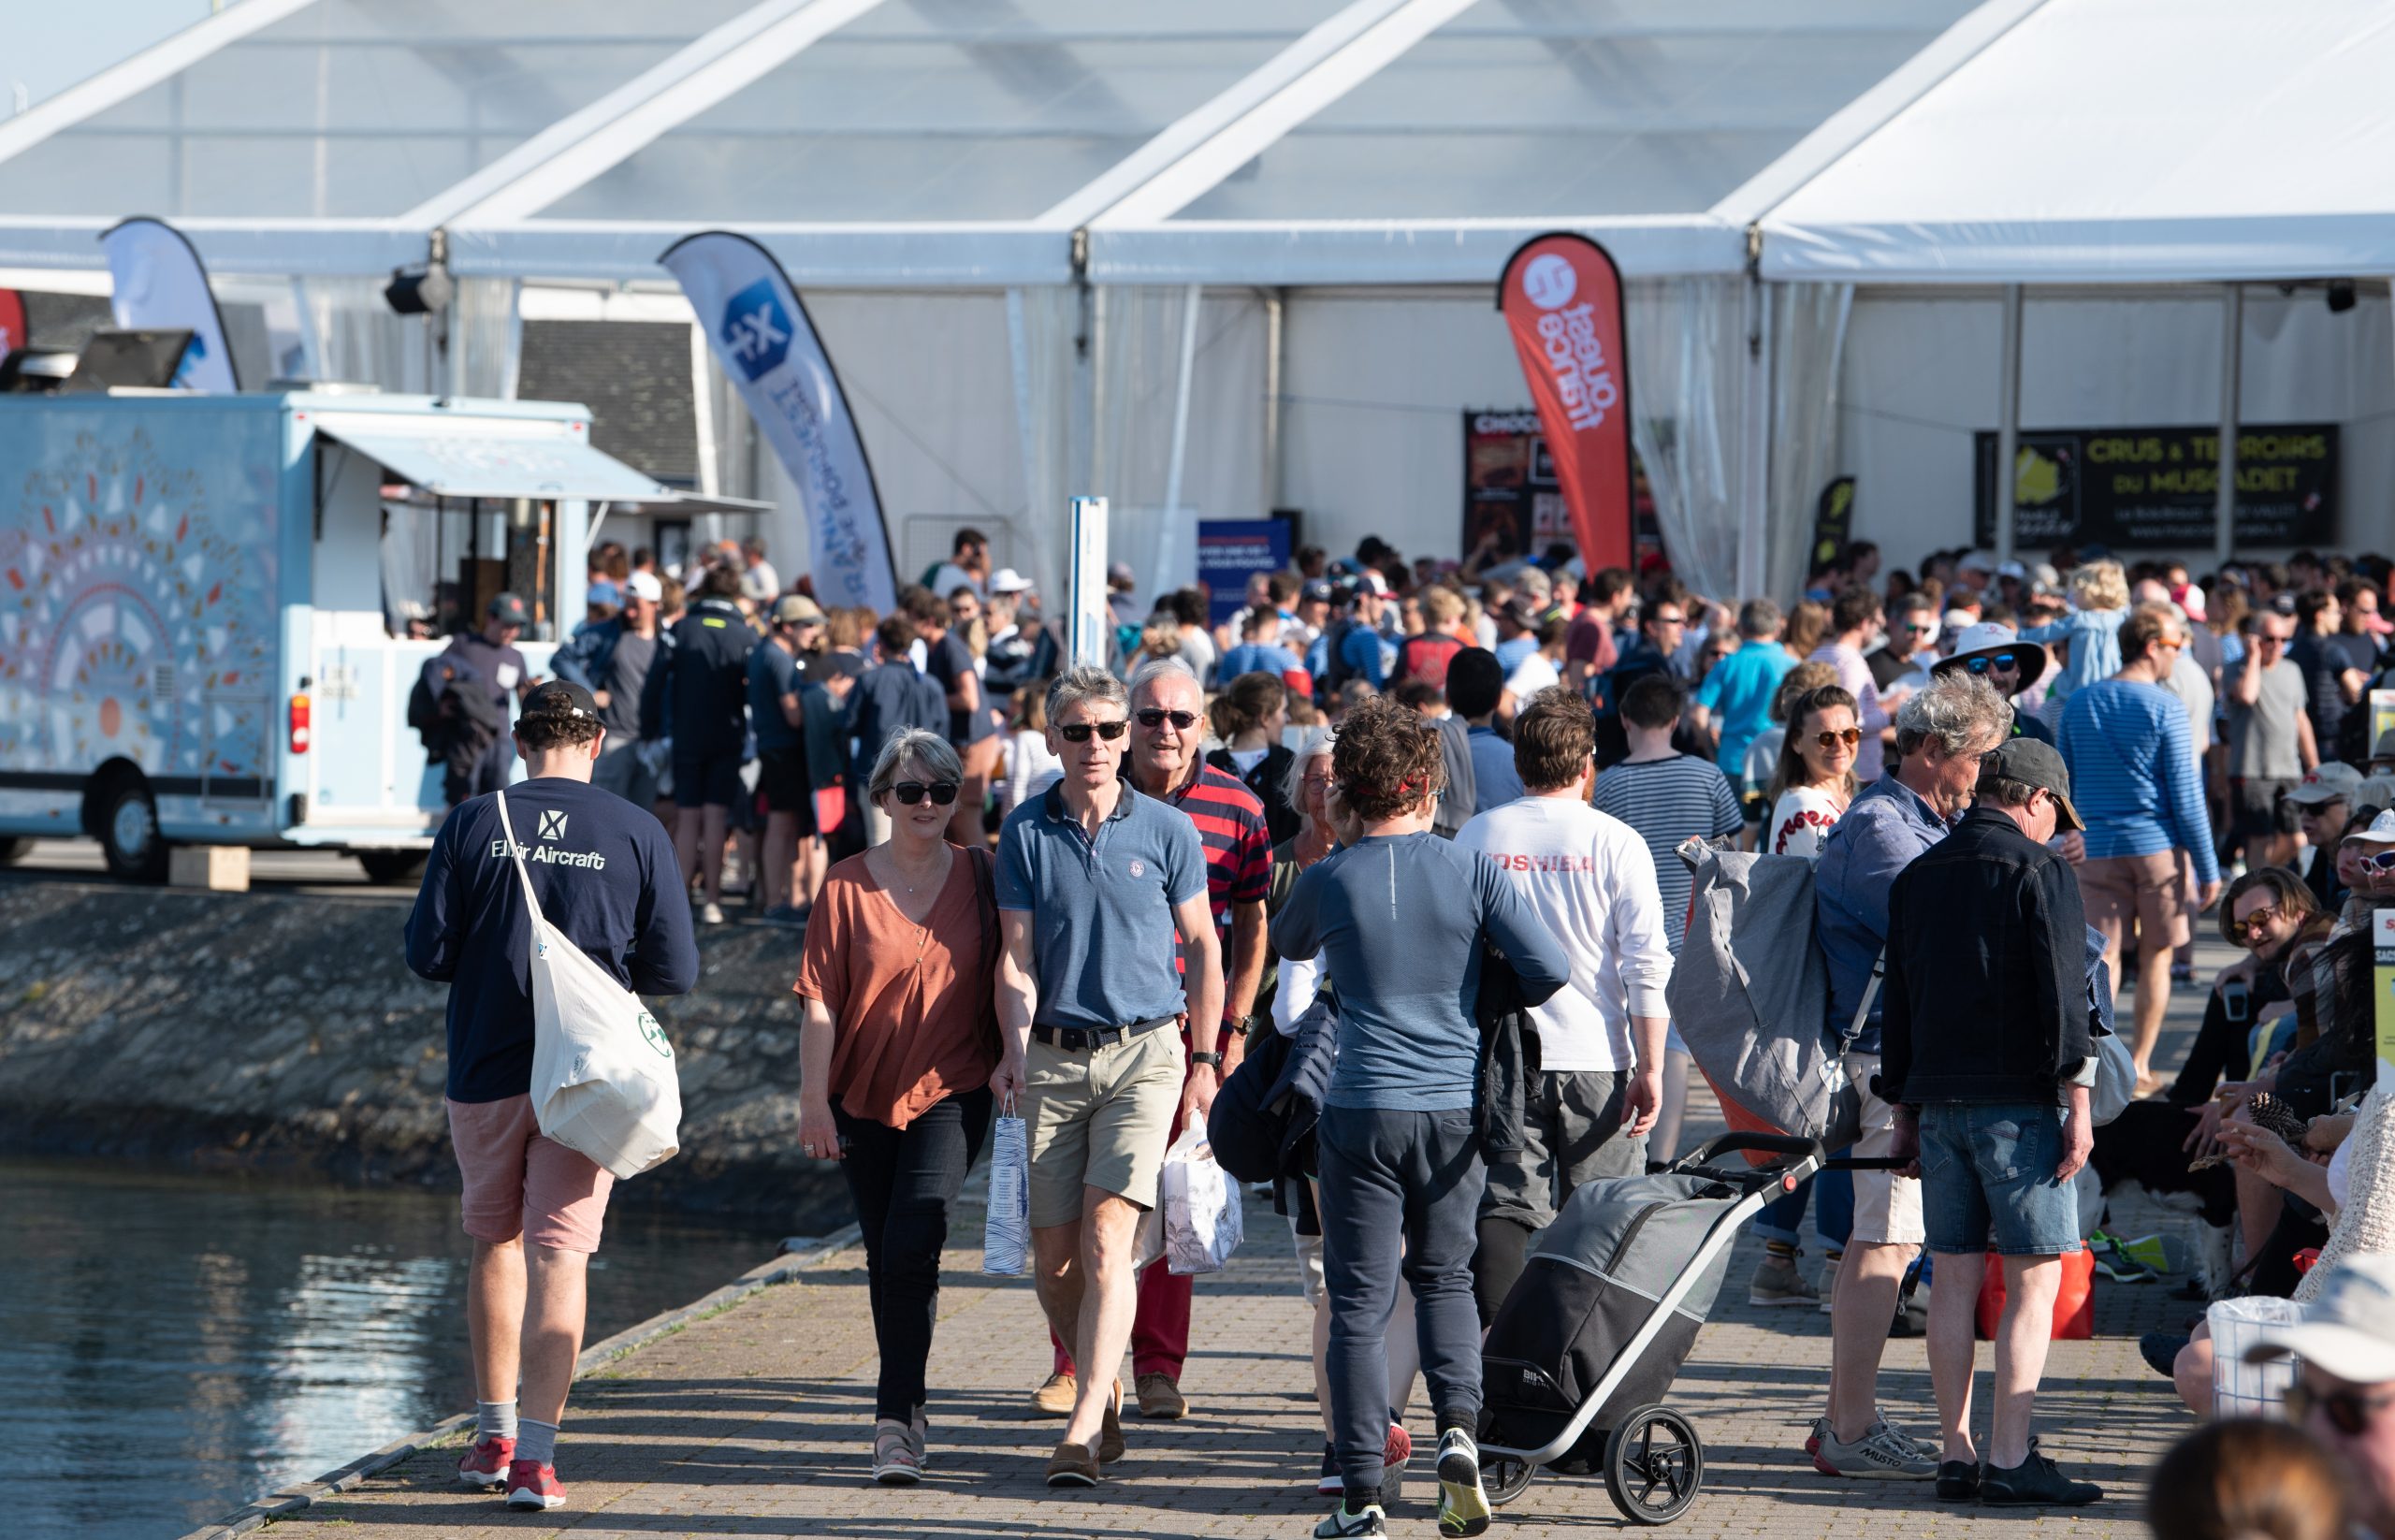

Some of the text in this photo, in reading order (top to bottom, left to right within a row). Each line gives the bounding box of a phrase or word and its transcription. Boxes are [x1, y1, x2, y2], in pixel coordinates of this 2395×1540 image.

[2087, 436, 2163, 463] CRUS
[2189, 434, 2328, 461] TEROIRS
[2112, 474, 2143, 494] DU
[531, 845, 605, 870] Aircraft
[1486, 852, 1594, 873] OSHIBA
[1858, 1447, 1902, 1467] MUSTO
